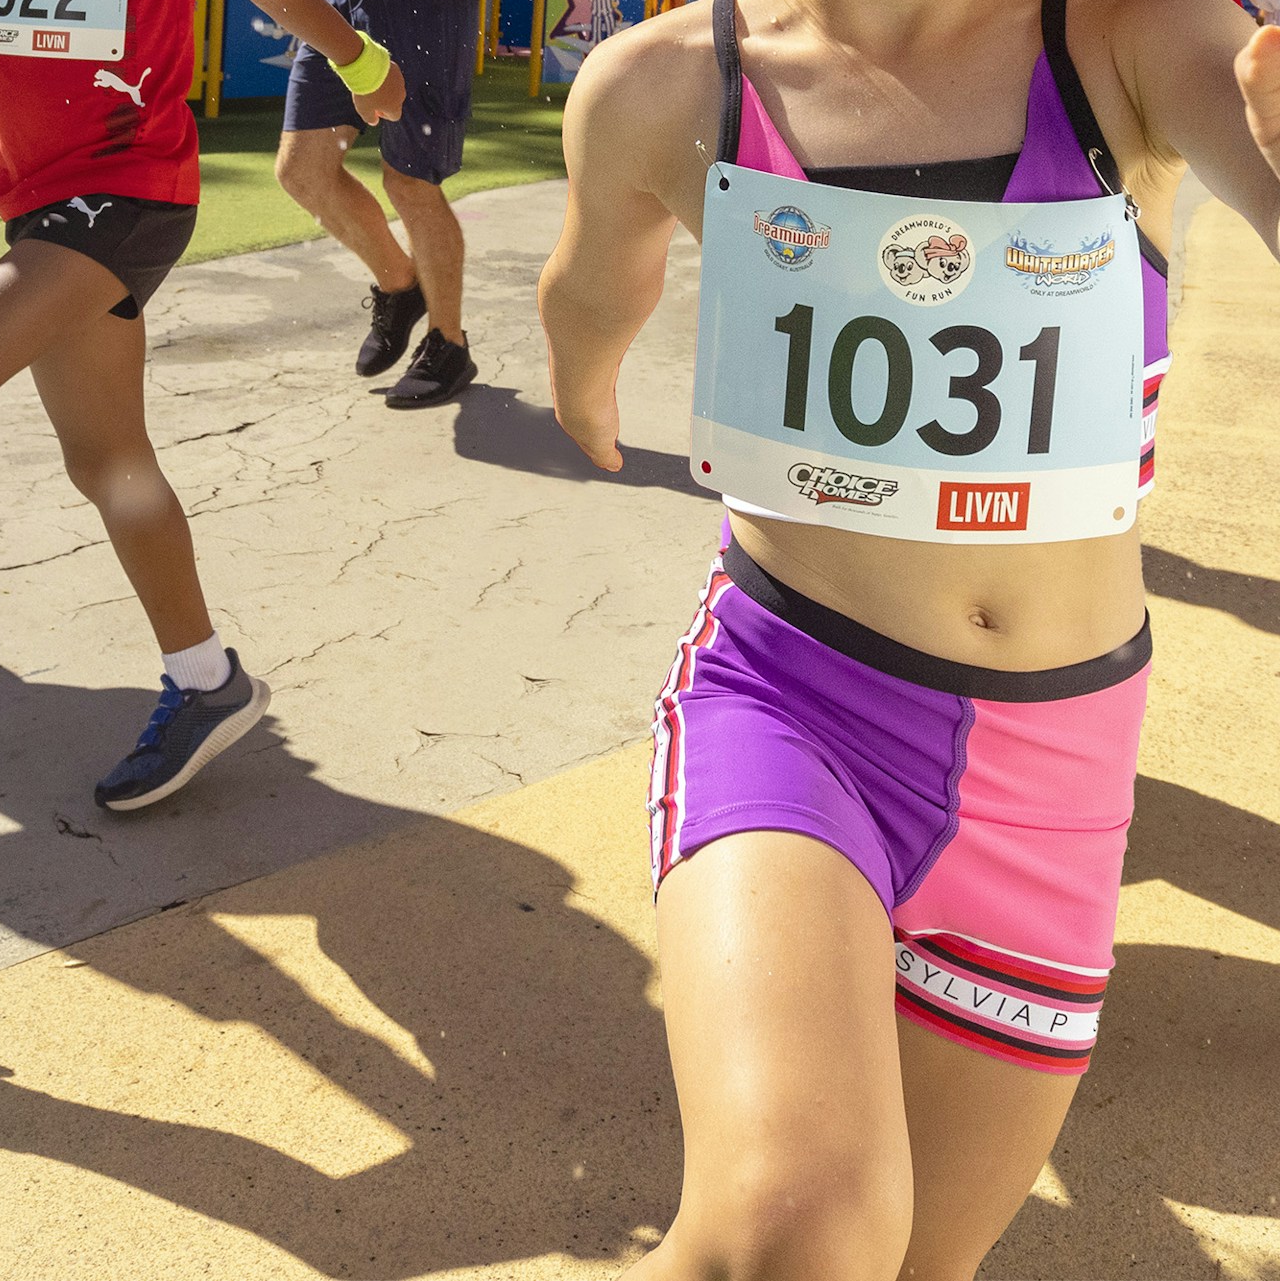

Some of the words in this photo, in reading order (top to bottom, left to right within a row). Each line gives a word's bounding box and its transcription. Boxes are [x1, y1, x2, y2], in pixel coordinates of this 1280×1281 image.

[36, 34, 65, 49] LIVIN
[753, 212, 832, 249] Dreamworld
[891, 220, 952, 241] DREAMWORLD'S
[1005, 239, 1115, 275] WHITEWATER
[1030, 288, 1046, 297] ONLY
[1055, 285, 1094, 297] DREAMWORLD
[1035, 271, 1090, 287] WORLD
[905, 290, 925, 302] FUN
[931, 288, 953, 302] RUN
[775, 303, 1061, 456] 1031
[787, 462, 899, 497] CHOICE
[799, 481, 883, 505] HOMES
[949, 491, 1019, 523] LIVIN
[895, 950, 1032, 1026] SYLVIA
[1050, 1013, 1068, 1033] P
